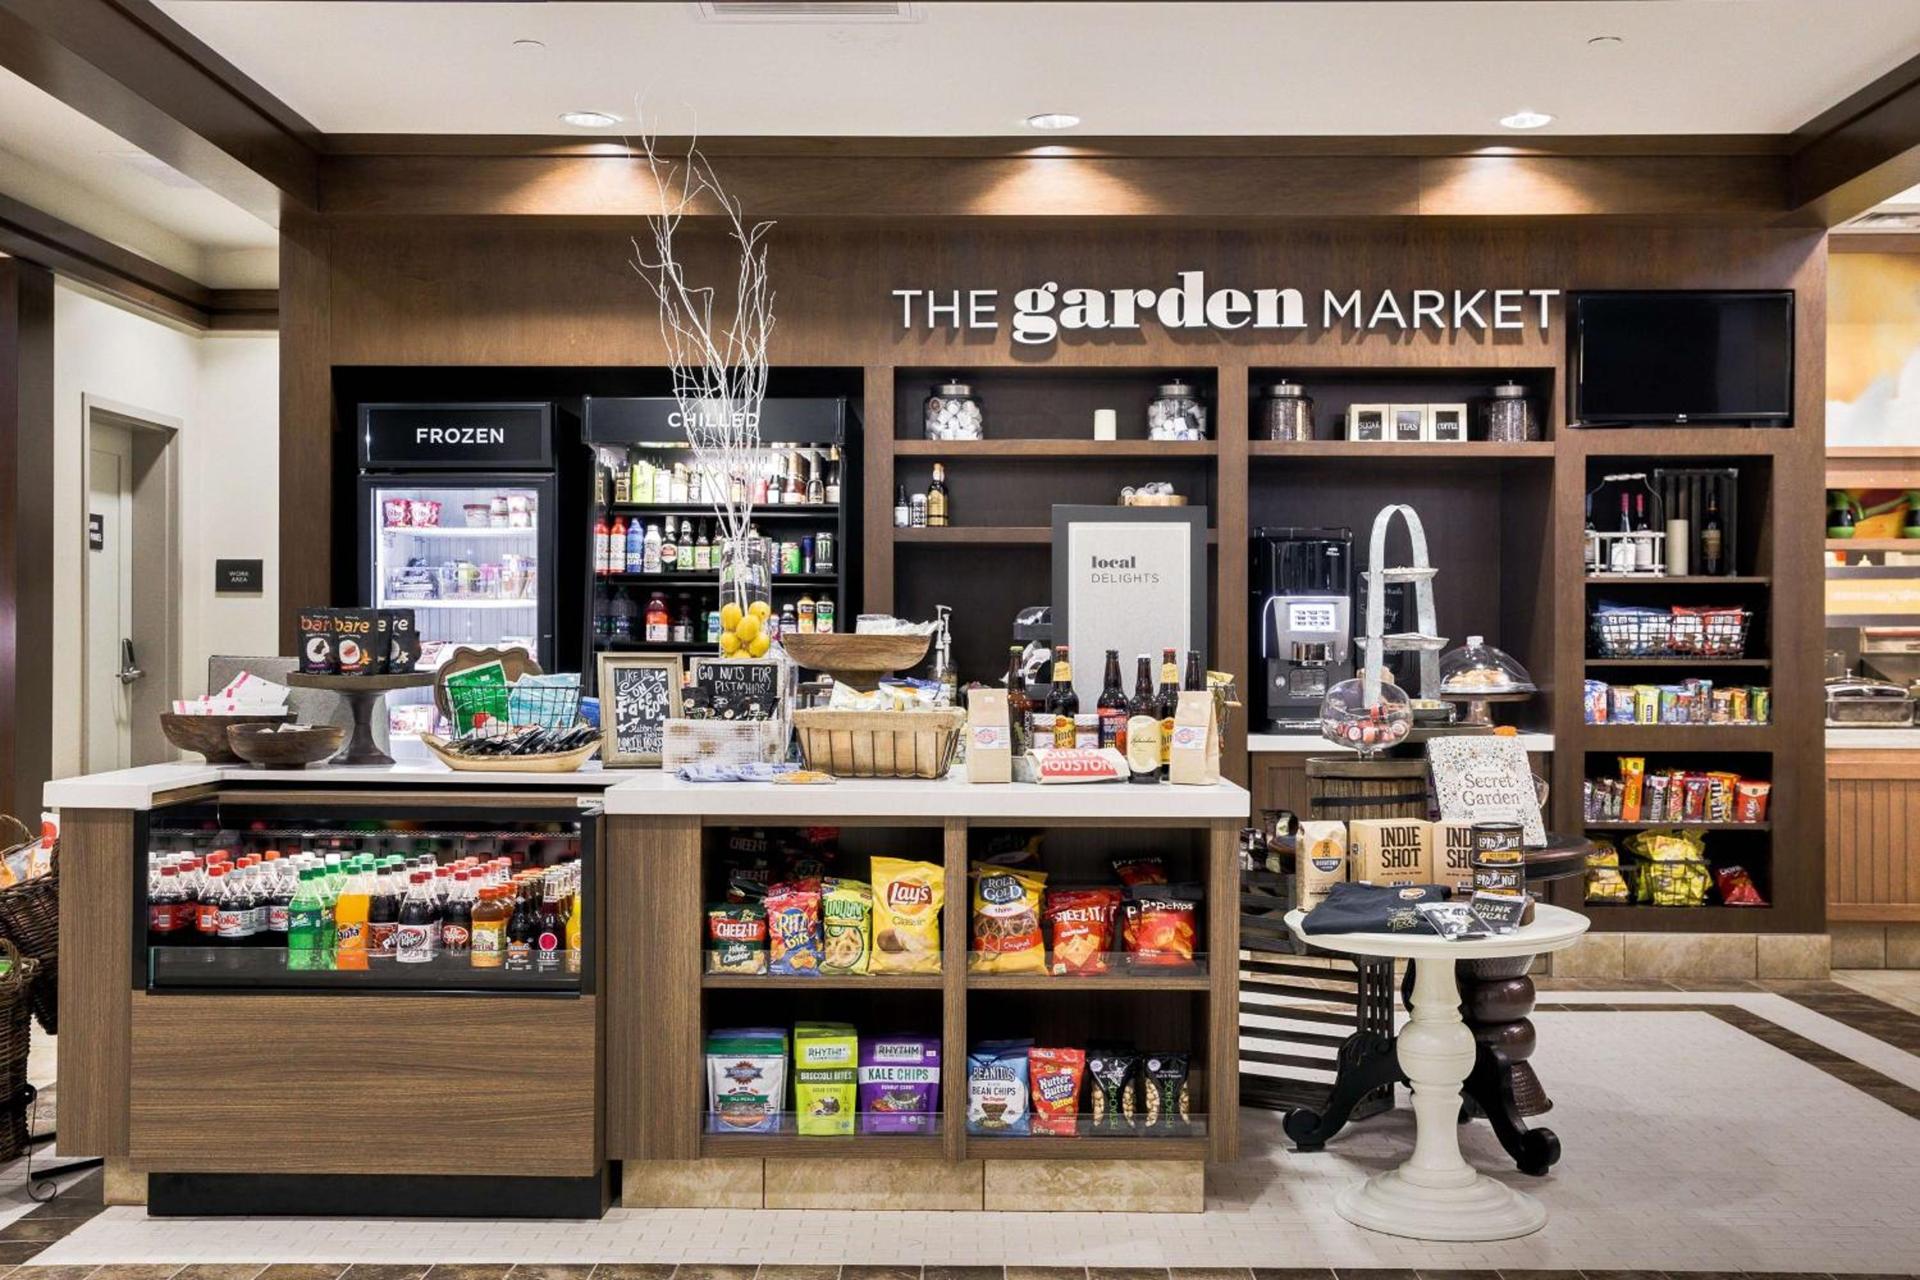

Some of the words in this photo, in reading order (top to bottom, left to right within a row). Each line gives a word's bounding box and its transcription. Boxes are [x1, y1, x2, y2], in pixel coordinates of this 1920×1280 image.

[892, 290, 998, 328] THE
[1012, 271, 1308, 344] garden
[1323, 289, 1560, 329] MARKET
[667, 412, 760, 428] CHILLED
[1399, 423, 1418, 431] TEAS
[416, 428, 504, 443] FROZEN
[1091, 556, 1136, 569] local
[1091, 573, 1160, 583] DELIGHTS
[301, 616, 332, 631] bar
[335, 617, 370, 633] bare
[393, 618, 409, 631] re
[699, 667, 714, 681] GO
[720, 666, 745, 681] NUTS
[752, 666, 772, 686] FOR
[1464, 772, 1514, 789] Secret
[1462, 790, 1521, 806] Garden
[1381, 826, 1421, 848] INDIE
[1446, 827, 1473, 848] IND
[1382, 848, 1421, 868] SHOT
[988, 877, 1016, 889] ROLD
[890, 882, 930, 905] Lay's
[983, 885, 1023, 901] GOLD
[1475, 903, 1512, 914] DRINK
[1479, 911, 1510, 921] OCAL
[716, 922, 759, 937] CHEEZ-IT
[539, 951, 556, 960] IZZE
[878, 1045, 920, 1055] RHYTHM
[800, 1071, 833, 1080] BROCCOLI
[868, 1068, 894, 1080] KALE
[896, 1068, 929, 1080] CHIPS
[973, 1066, 1016, 1082] BEANITOS
[1039, 1075, 1071, 1091] Nutter
[972, 1086, 992, 1095] BEAN
[993, 1086, 1016, 1096] CHIPS
[1043, 1083, 1074, 1099] Butter
